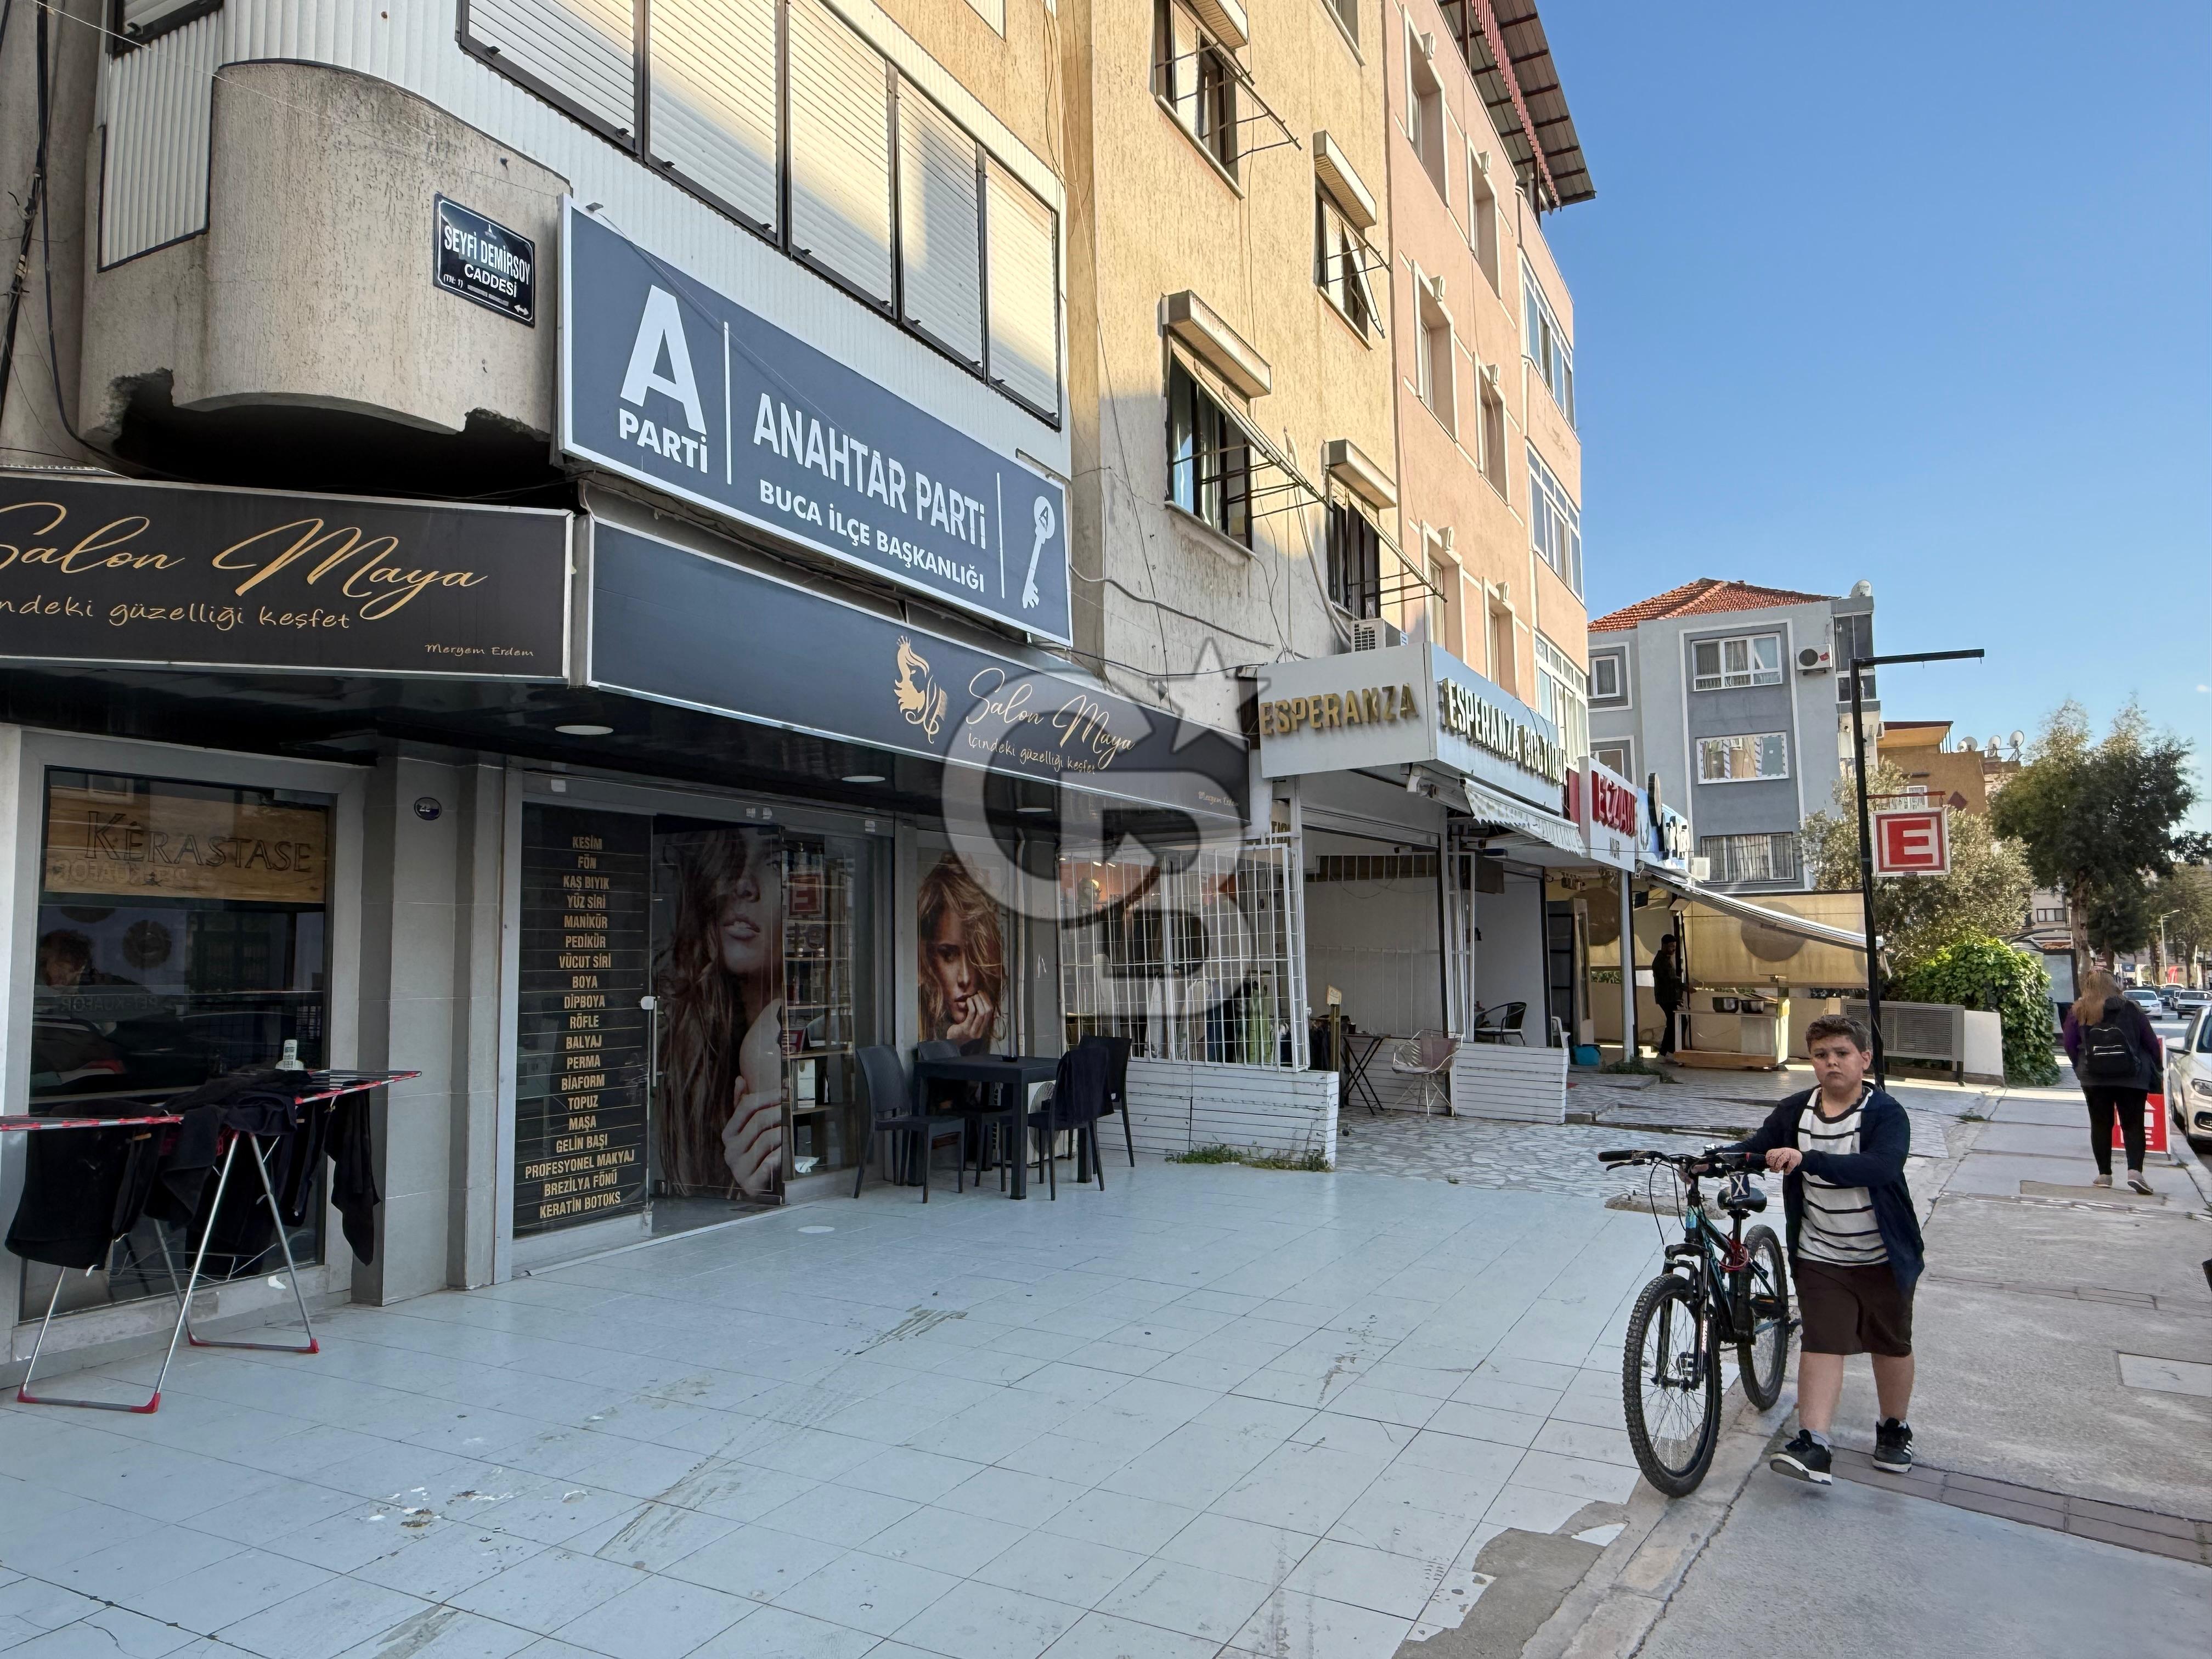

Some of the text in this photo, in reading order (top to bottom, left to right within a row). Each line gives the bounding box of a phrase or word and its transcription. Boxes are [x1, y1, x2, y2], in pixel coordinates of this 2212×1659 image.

[444, 225, 530, 285] SEYFİ DEMİRSOY
[464, 263, 517, 298] CADDESİ
[620, 285, 707, 435] A
[619, 408, 708, 473] PARTİ
[753, 392, 986, 550] ANAHTAR PARTİ
[759, 479, 985, 594] BUCA İLÇE BAŞKANLIĞI
[0, 501, 488, 621] Salon Maya
[109, 601, 245, 631] güzelliği
[259, 607, 351, 630] keşfet
[491, 647, 534, 657] Erdem
[966, 667, 1136, 770] Salon Maya
[1260, 682, 1419, 736] ESPERANZA
[1442, 677, 1521, 763] ESPERANZA
[968, 726, 1015, 757] İçindeki
[572, 835, 602, 850] KESİM
[1887, 820, 1933, 865] E
[578, 853, 597, 870] FÖN
[563, 875, 610, 891] KAŞ BIYIK
[567, 893, 585, 909] YÜZ
[563, 913, 608, 929] MANİKÜR
[566, 933, 606, 949] PEDİKÜR
[558, 953, 590, 969] VÜCUT
[572, 975, 598, 989] BOYA
[564, 994, 606, 1009] DİPBOYA
[569, 1013, 600, 1029] RÖFLE
[566, 1035, 602, 1049] BALYAJ
[567, 1054, 601, 1070] PERMA
[561, 1074, 605, 1091] BİAFORM
[568, 1095, 599, 1111] TOPUZ
[568, 1115, 597, 1132] MAŞA
[556, 1133, 608, 1153] GELİN BAŞI
[525, 1149, 635, 1179] PROFESYONEL MAKYAJ
[544, 1168, 618, 1197] BREZİLYA FÖNÜ
[539, 1191, 621, 1220] KERATİN BOTOKS
